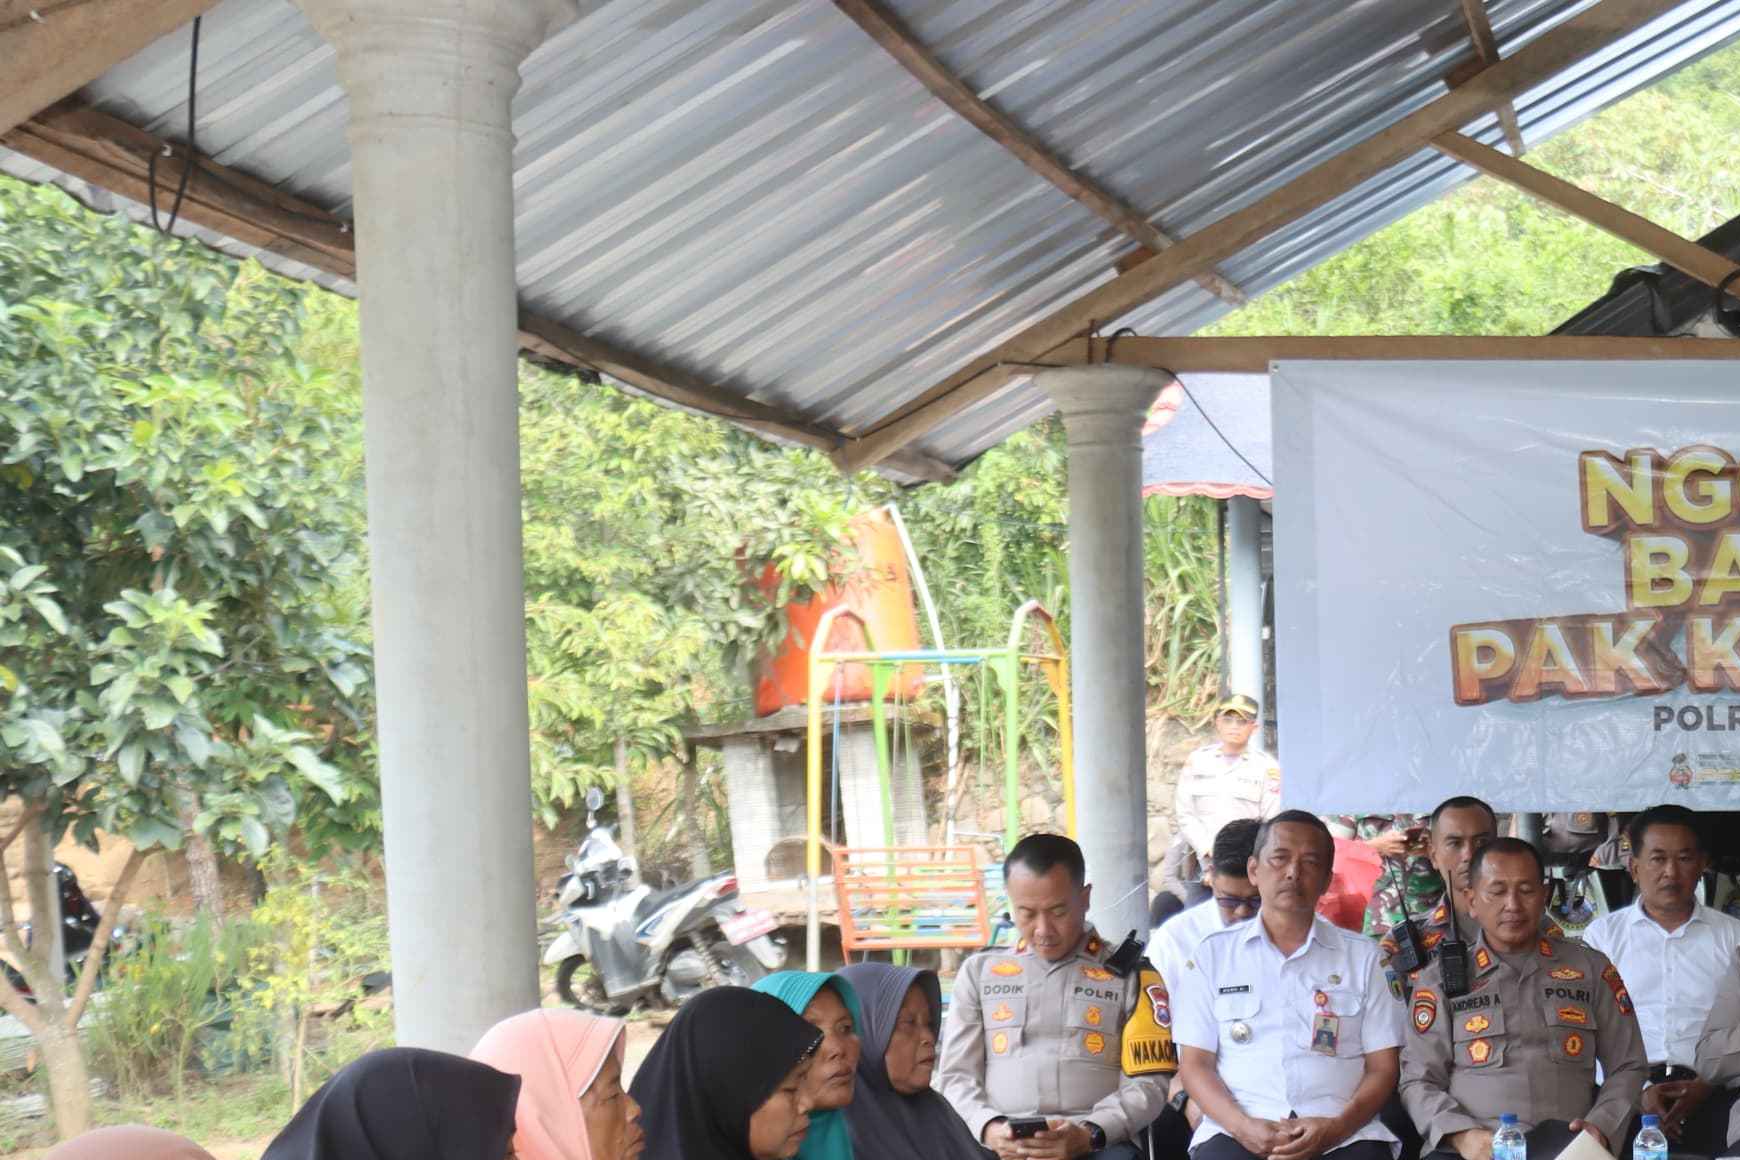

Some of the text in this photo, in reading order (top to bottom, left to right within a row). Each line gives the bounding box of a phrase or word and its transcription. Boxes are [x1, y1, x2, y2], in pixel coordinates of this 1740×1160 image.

[1456, 616, 1664, 700] PAK
[983, 984, 1025, 996] DODIK
[1073, 986, 1120, 1001] POLRI
[1544, 987, 1592, 1003] POLRI
